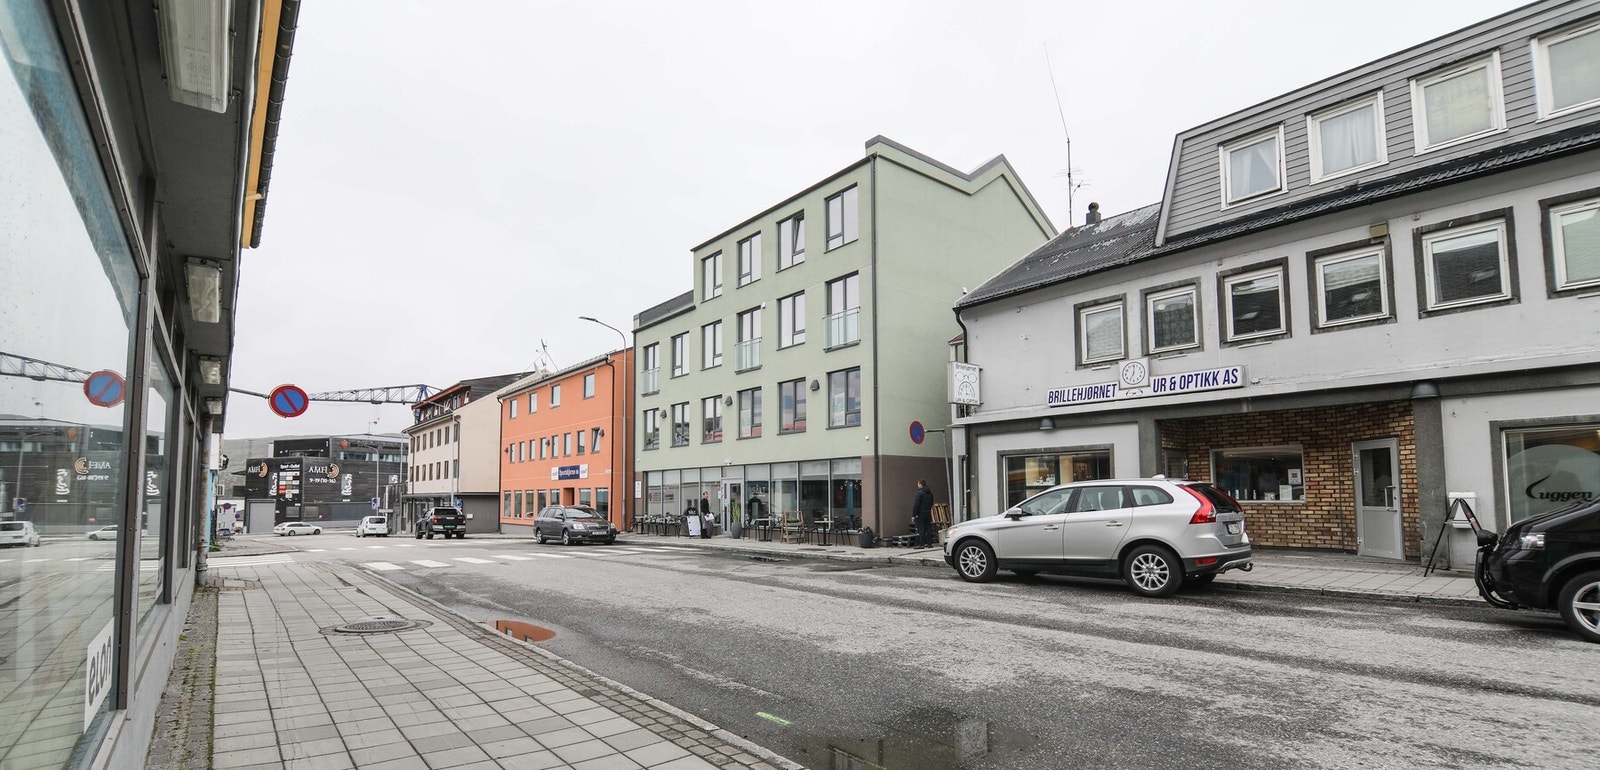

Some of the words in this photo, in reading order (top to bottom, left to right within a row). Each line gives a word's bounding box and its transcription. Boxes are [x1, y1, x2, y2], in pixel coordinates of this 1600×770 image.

[1048, 383, 1117, 404] BRILLEHJØRNET
[1153, 378, 1166, 393] UR
[1169, 376, 1176, 391] &
[1179, 371, 1220, 389] OPTIKK
[1222, 368, 1239, 385] AS
